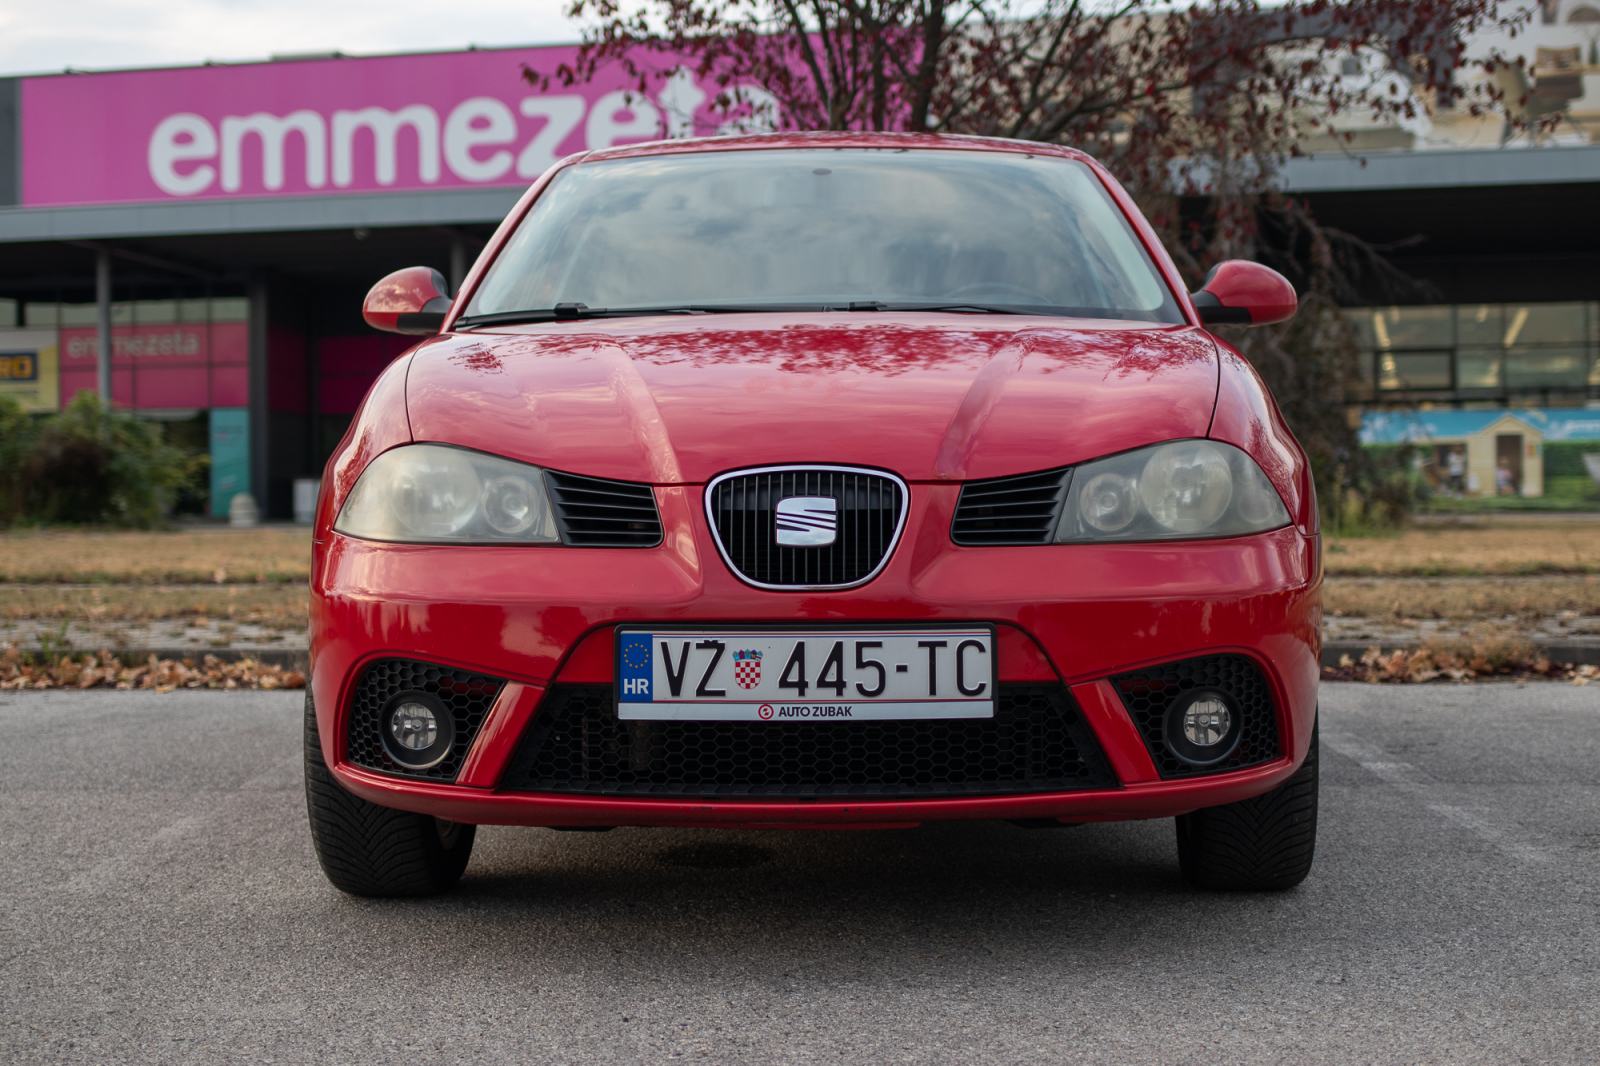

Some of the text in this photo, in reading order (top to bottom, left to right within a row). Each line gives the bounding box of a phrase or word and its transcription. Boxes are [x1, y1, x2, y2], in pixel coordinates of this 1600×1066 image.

[660, 639, 726, 697] VŽ
[623, 678, 649, 695] HR
[778, 705, 853, 717] AUTO ZUBAK
